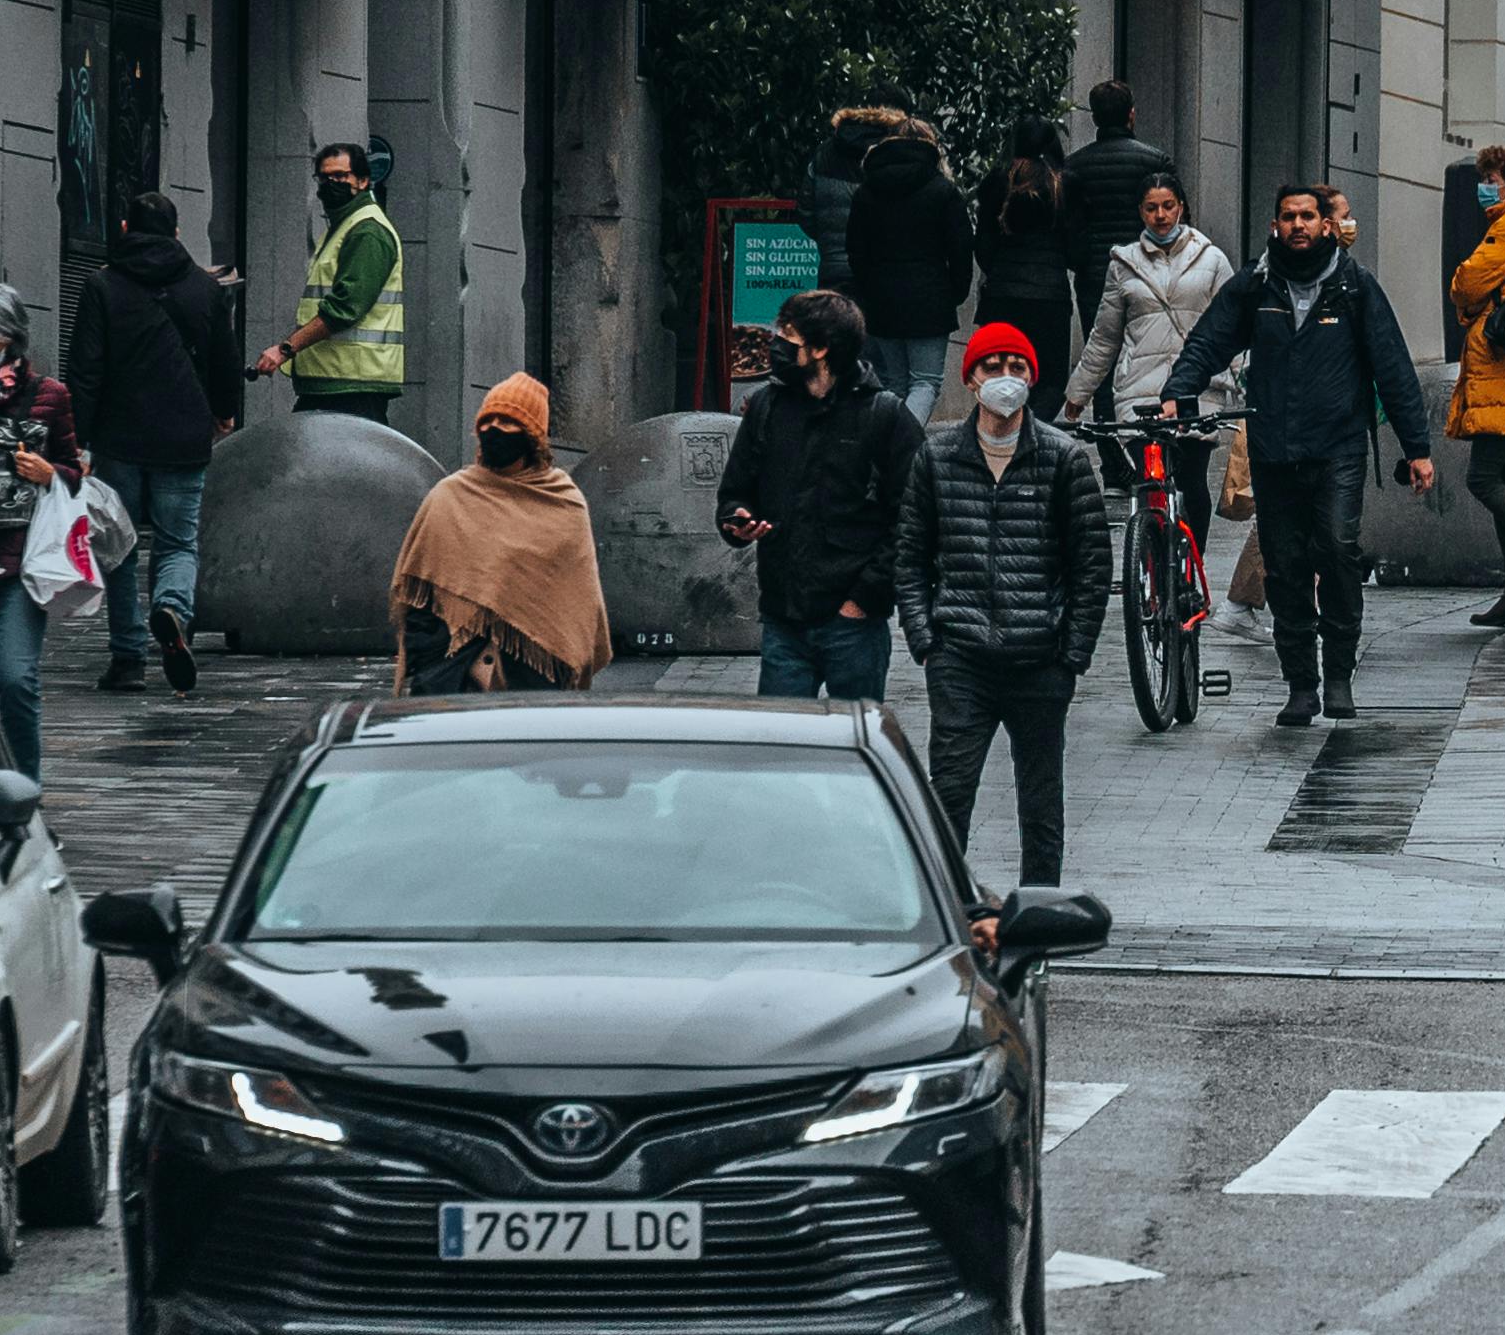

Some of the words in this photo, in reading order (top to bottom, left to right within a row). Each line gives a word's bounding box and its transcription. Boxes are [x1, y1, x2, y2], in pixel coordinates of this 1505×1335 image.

[746, 238, 766, 250] SIN
[769, 236, 818, 250] AZÚCAR
[746, 252, 766, 263] SIN
[768, 253, 818, 263] GLUTEN
[745, 266, 766, 276] SIN
[768, 266, 819, 277] ADITIVO
[475, 1211, 590, 1253] 7677
[606, 1211, 690, 1252] LDC
